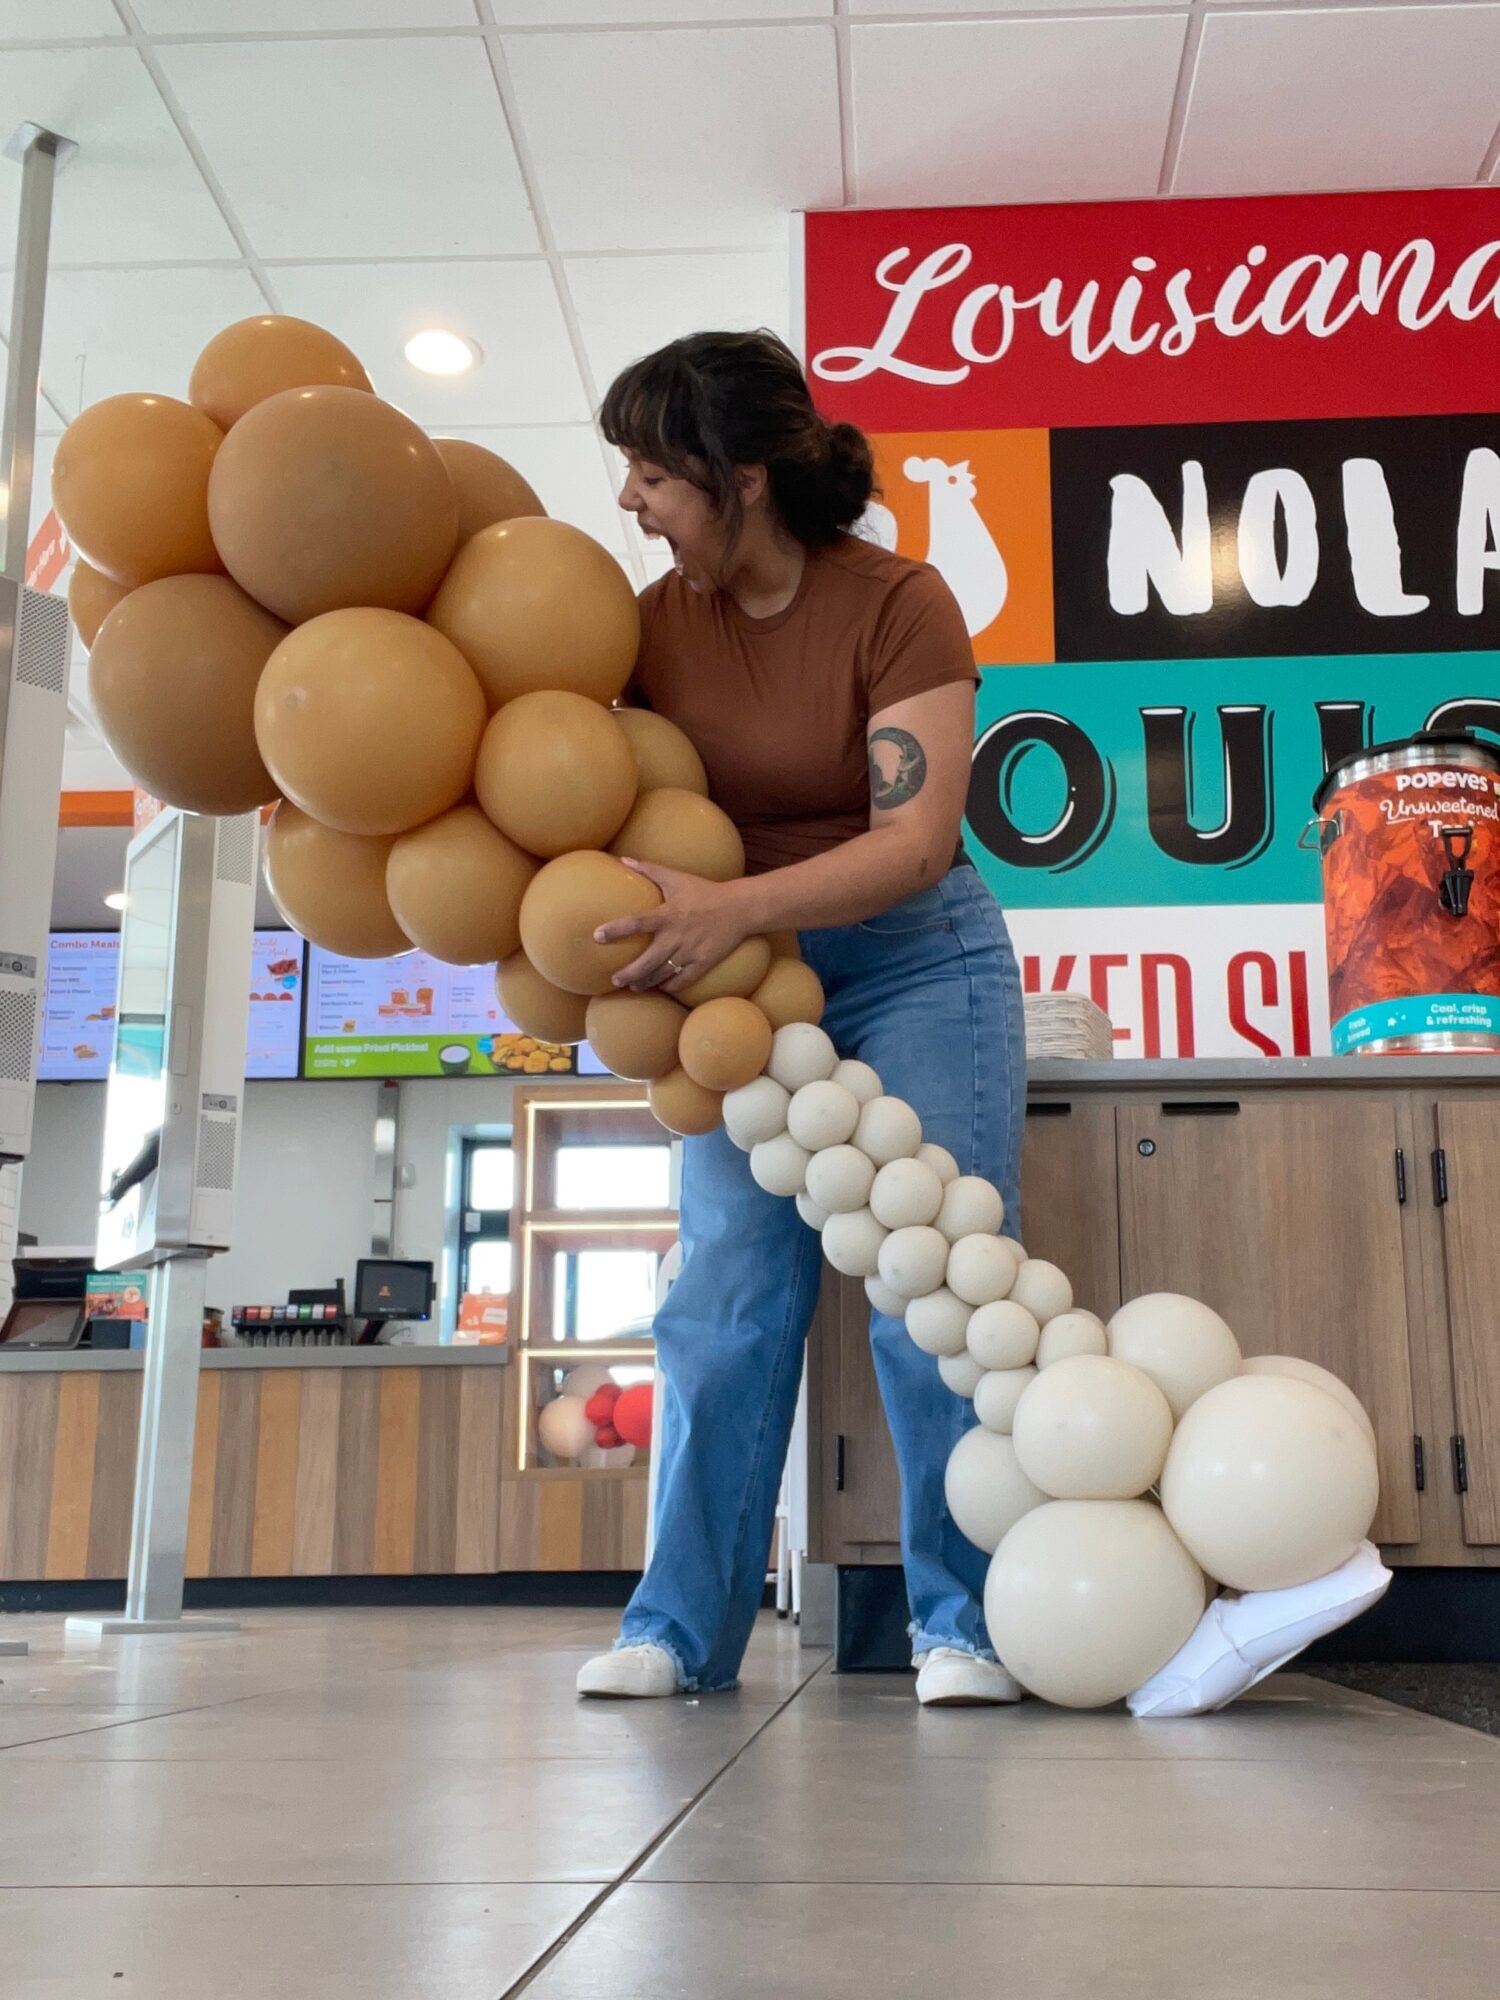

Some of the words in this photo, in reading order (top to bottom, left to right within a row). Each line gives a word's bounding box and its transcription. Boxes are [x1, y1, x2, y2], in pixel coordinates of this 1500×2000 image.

[1108, 446, 1500, 616] NOLA
[963, 697, 1500, 873] OU
[1379, 796, 1500, 824] Unsweetened
[50, 939, 89, 949] Combo
[1430, 1003, 1460, 1014] Cool,
[1461, 1003, 1487, 1015] crisp
[1426, 1015, 1434, 1026] &
[1436, 1013, 1492, 1028] refreshing
